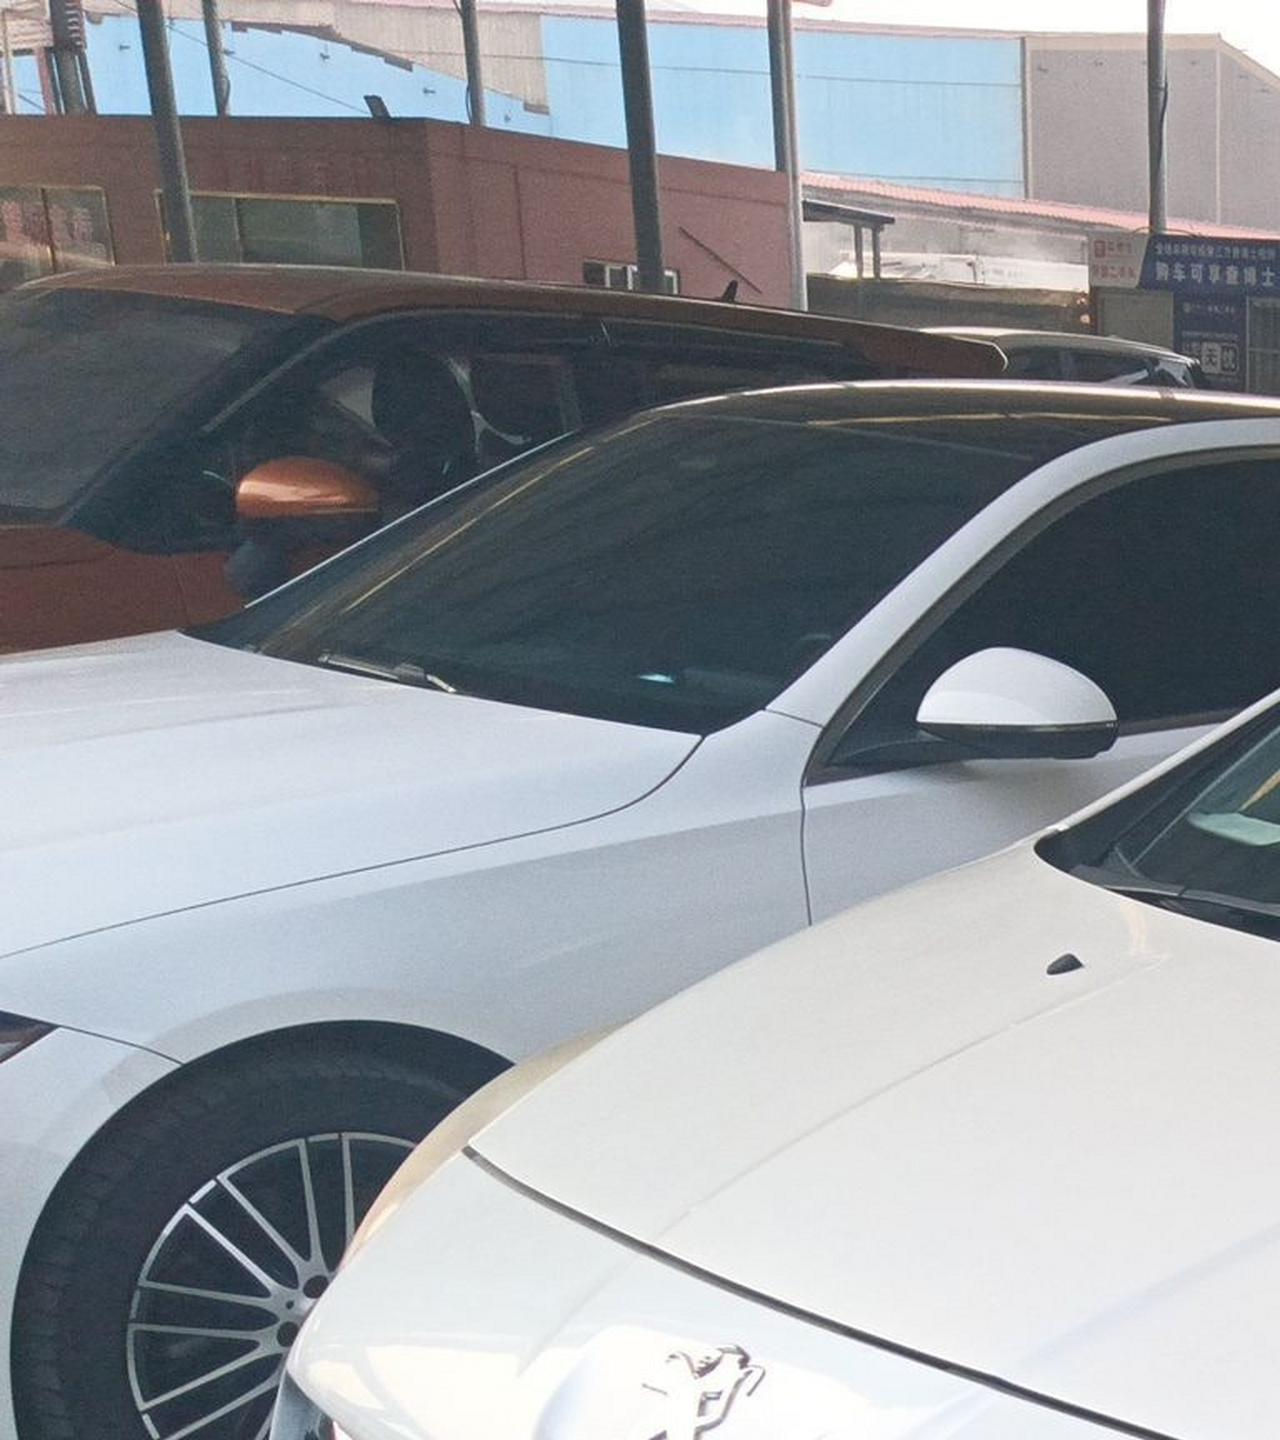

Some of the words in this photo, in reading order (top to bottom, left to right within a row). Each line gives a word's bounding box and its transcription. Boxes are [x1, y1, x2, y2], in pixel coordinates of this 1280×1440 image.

[1156, 262, 1275, 287] 购车可享查博士
